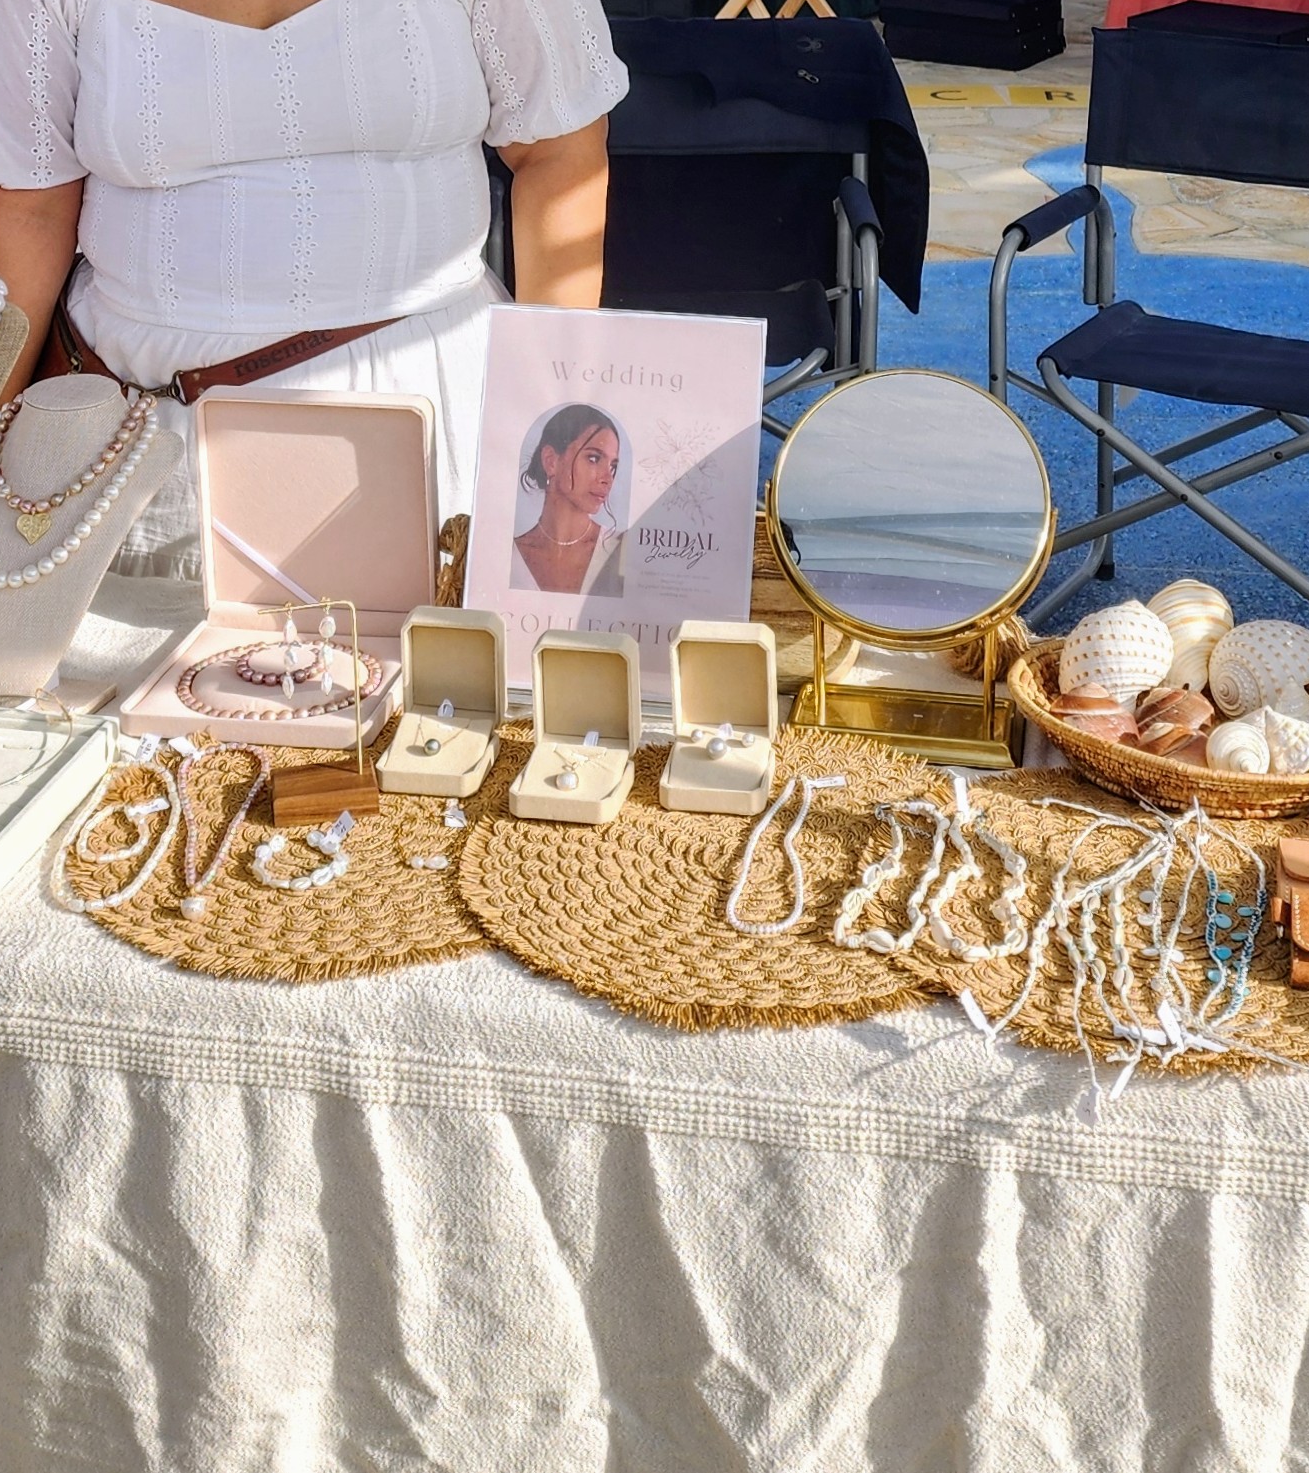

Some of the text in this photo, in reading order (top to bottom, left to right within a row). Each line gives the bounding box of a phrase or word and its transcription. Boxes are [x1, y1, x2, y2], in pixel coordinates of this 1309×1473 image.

[1044, 90, 1077, 102] R
[550, 360, 685, 393] Wedding
[638, 527, 720, 552] BRIDAL
[644, 538, 708, 570] Jewelry
